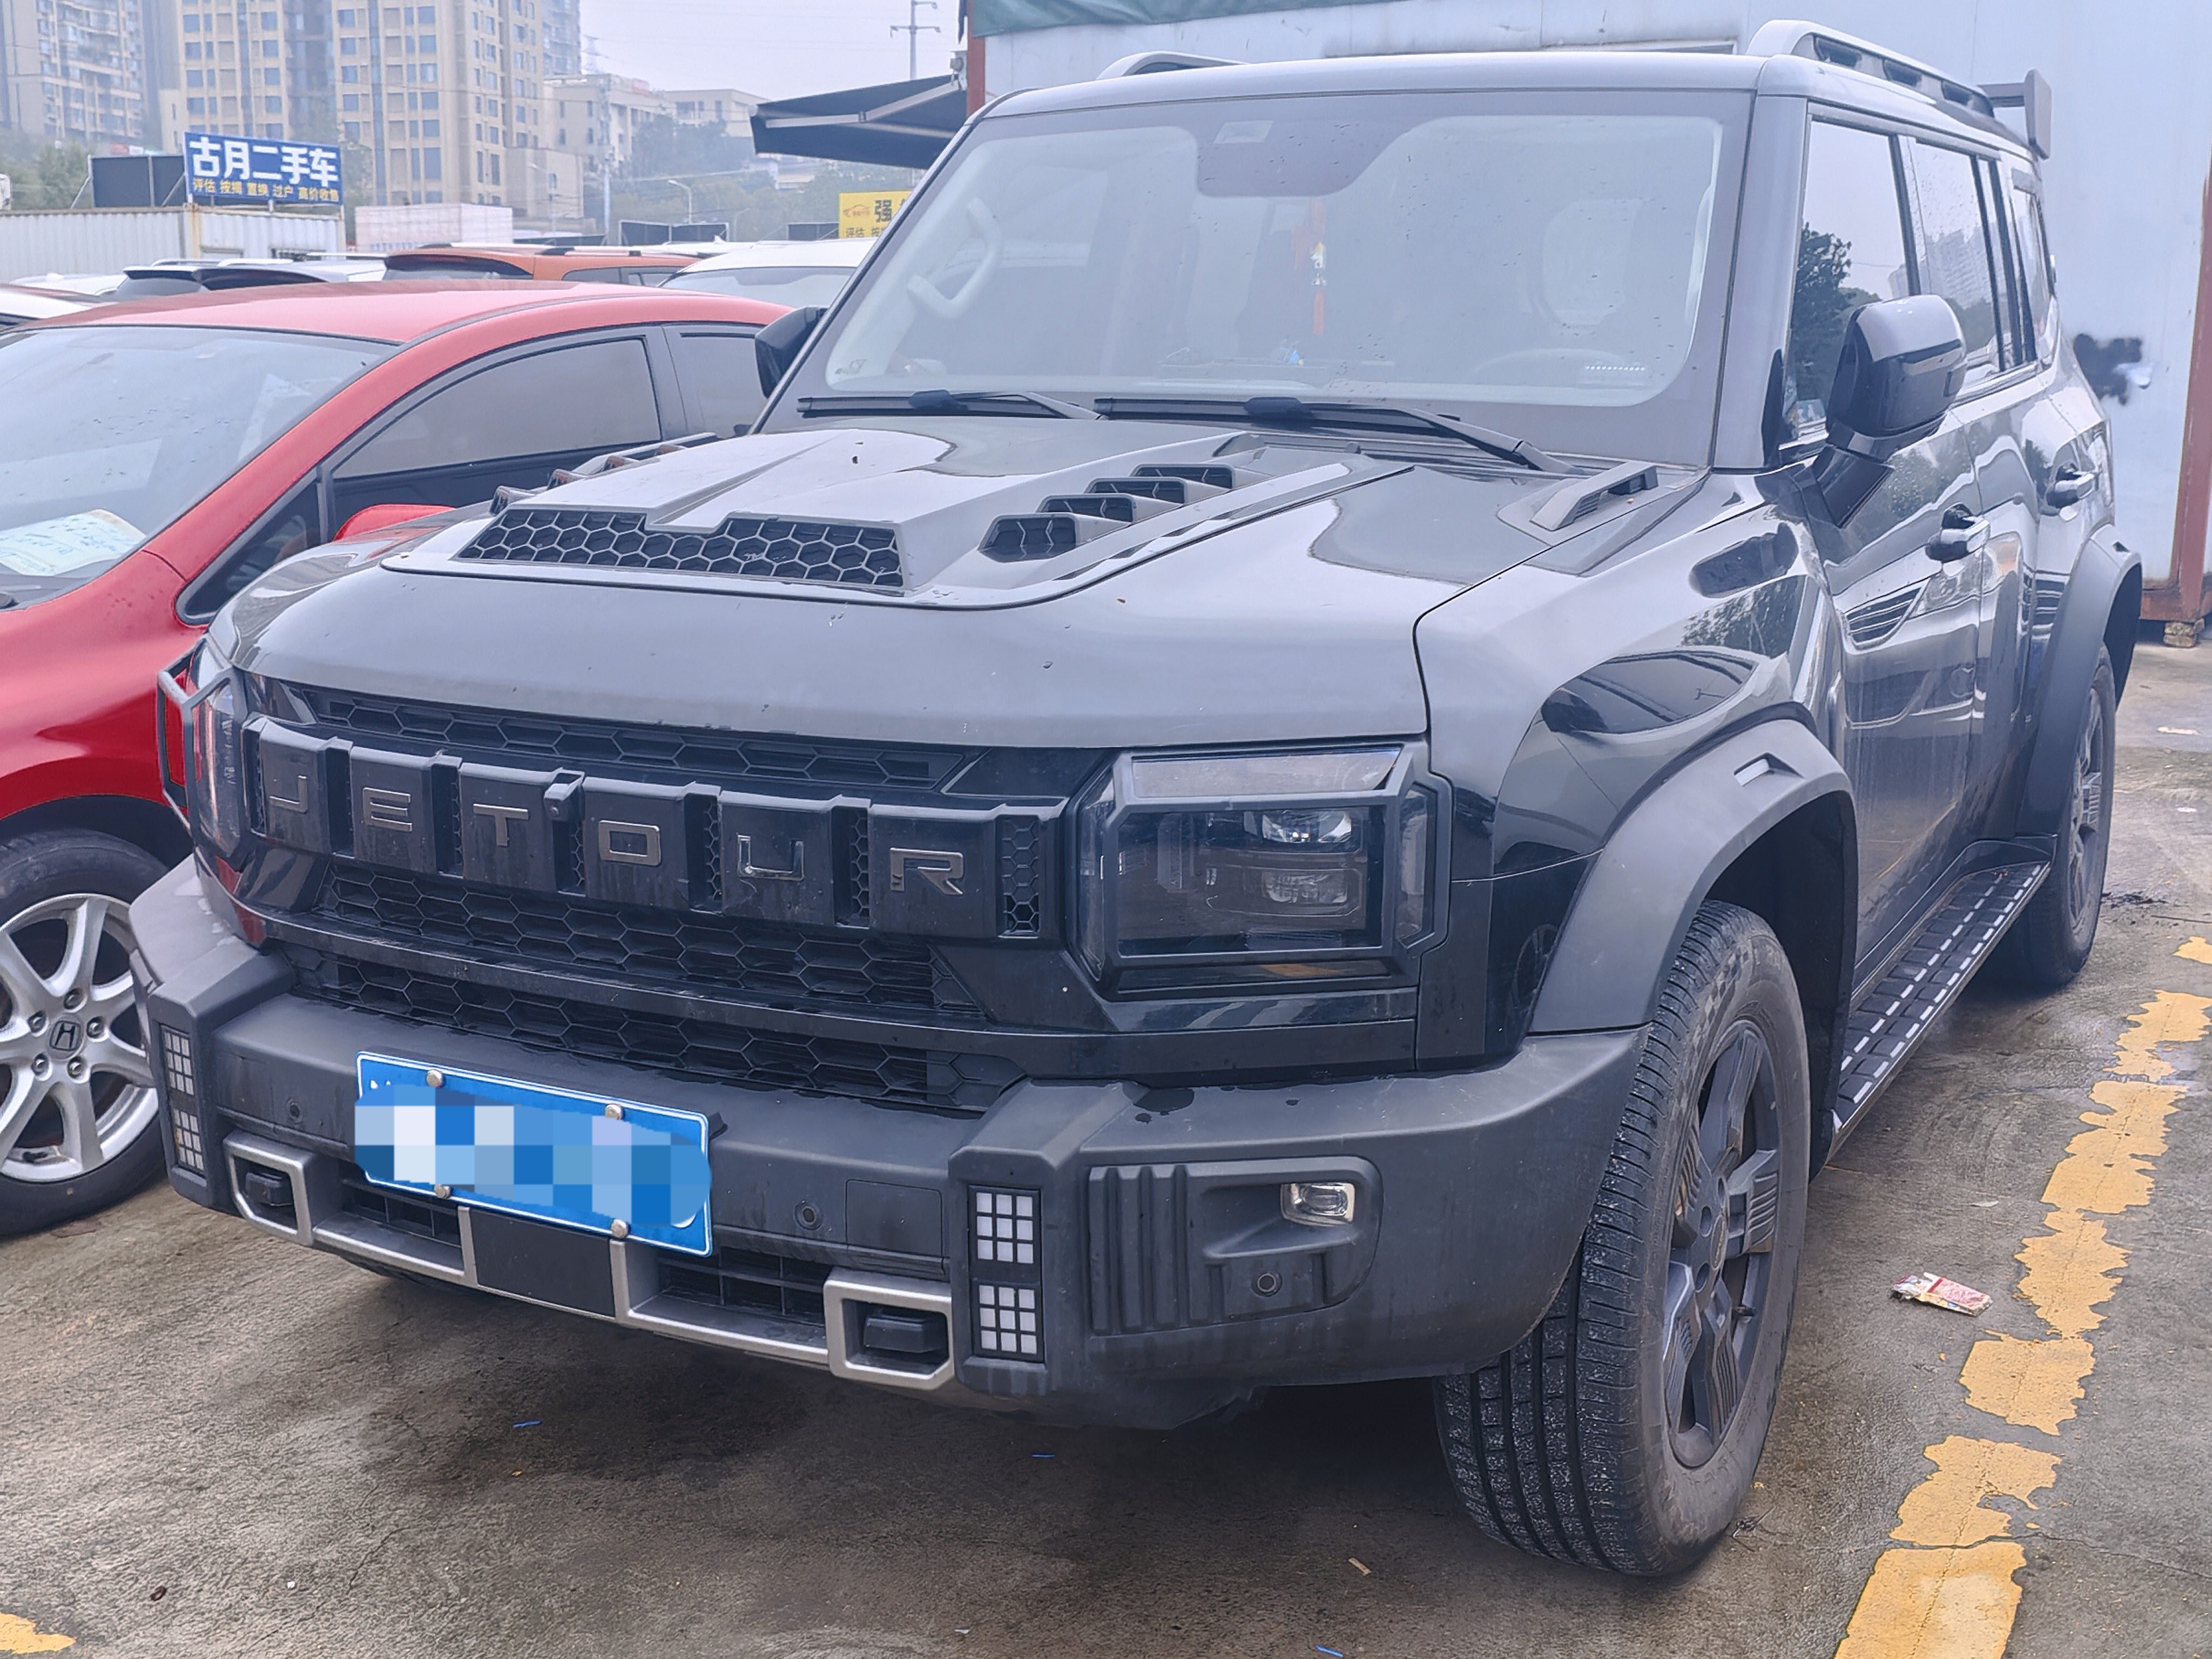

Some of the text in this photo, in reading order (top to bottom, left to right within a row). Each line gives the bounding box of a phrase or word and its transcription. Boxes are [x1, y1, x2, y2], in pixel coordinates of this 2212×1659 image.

[189, 137, 339, 187] 古月二手车
[193, 178, 216, 193] 评估
[273, 184, 294, 198] 过户
[267, 774, 965, 897] JETOUR
